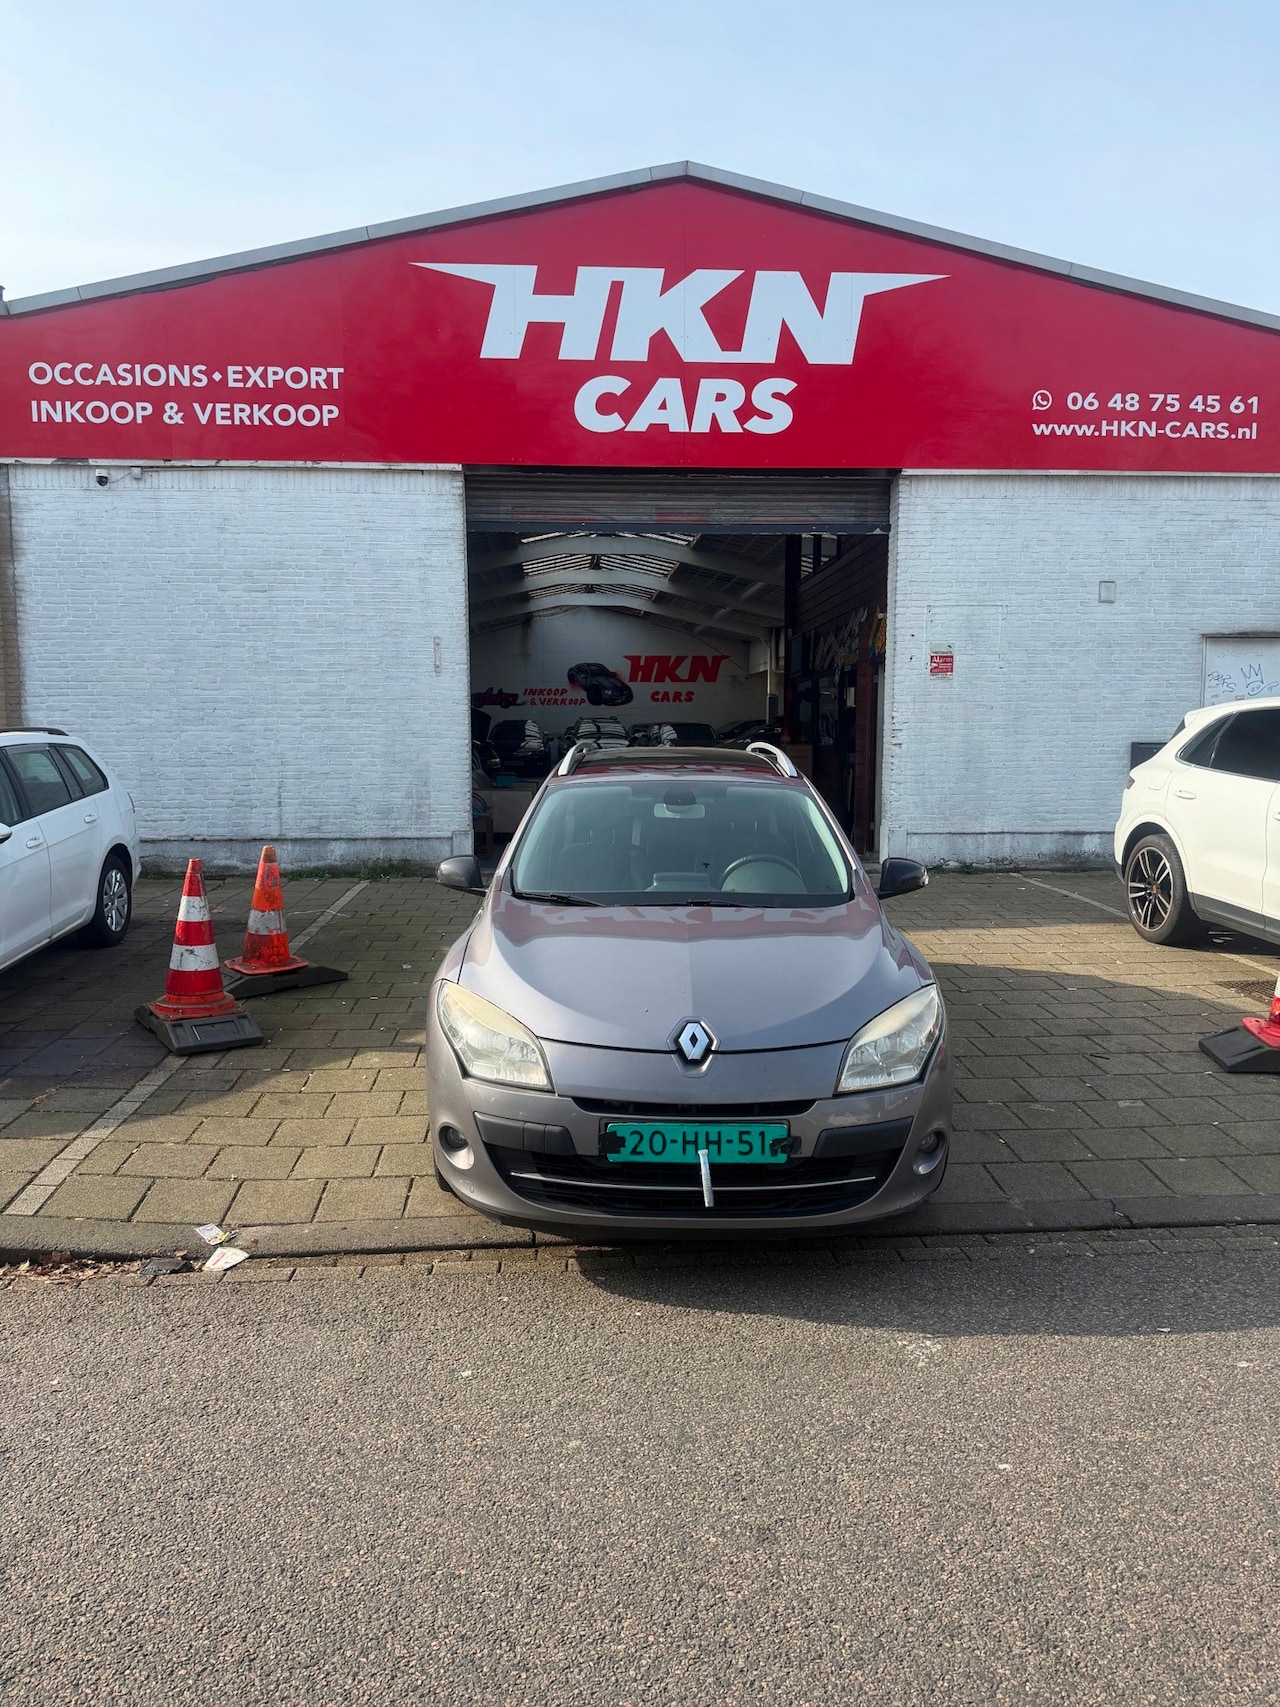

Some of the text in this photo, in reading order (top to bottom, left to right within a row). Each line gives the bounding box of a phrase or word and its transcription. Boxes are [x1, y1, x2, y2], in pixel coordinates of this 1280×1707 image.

[410, 263, 950, 364] HKN
[29, 362, 344, 389] OCCASIONS EXPORT
[32, 401, 339, 426] INKOOP & VERKOOP
[574, 375, 797, 434] CARS
[1067, 392, 1258, 413] 06 48 75 45 61
[1032, 420, 1258, 439] www.HKN-CARS.nl
[624, 655, 730, 683] HKN
[523, 688, 567, 697] INKOOP
[540, 698, 586, 706] VERKOOP
[650, 691, 695, 703] CARS
[628, 1130, 767, 1156] 20-HH-51
